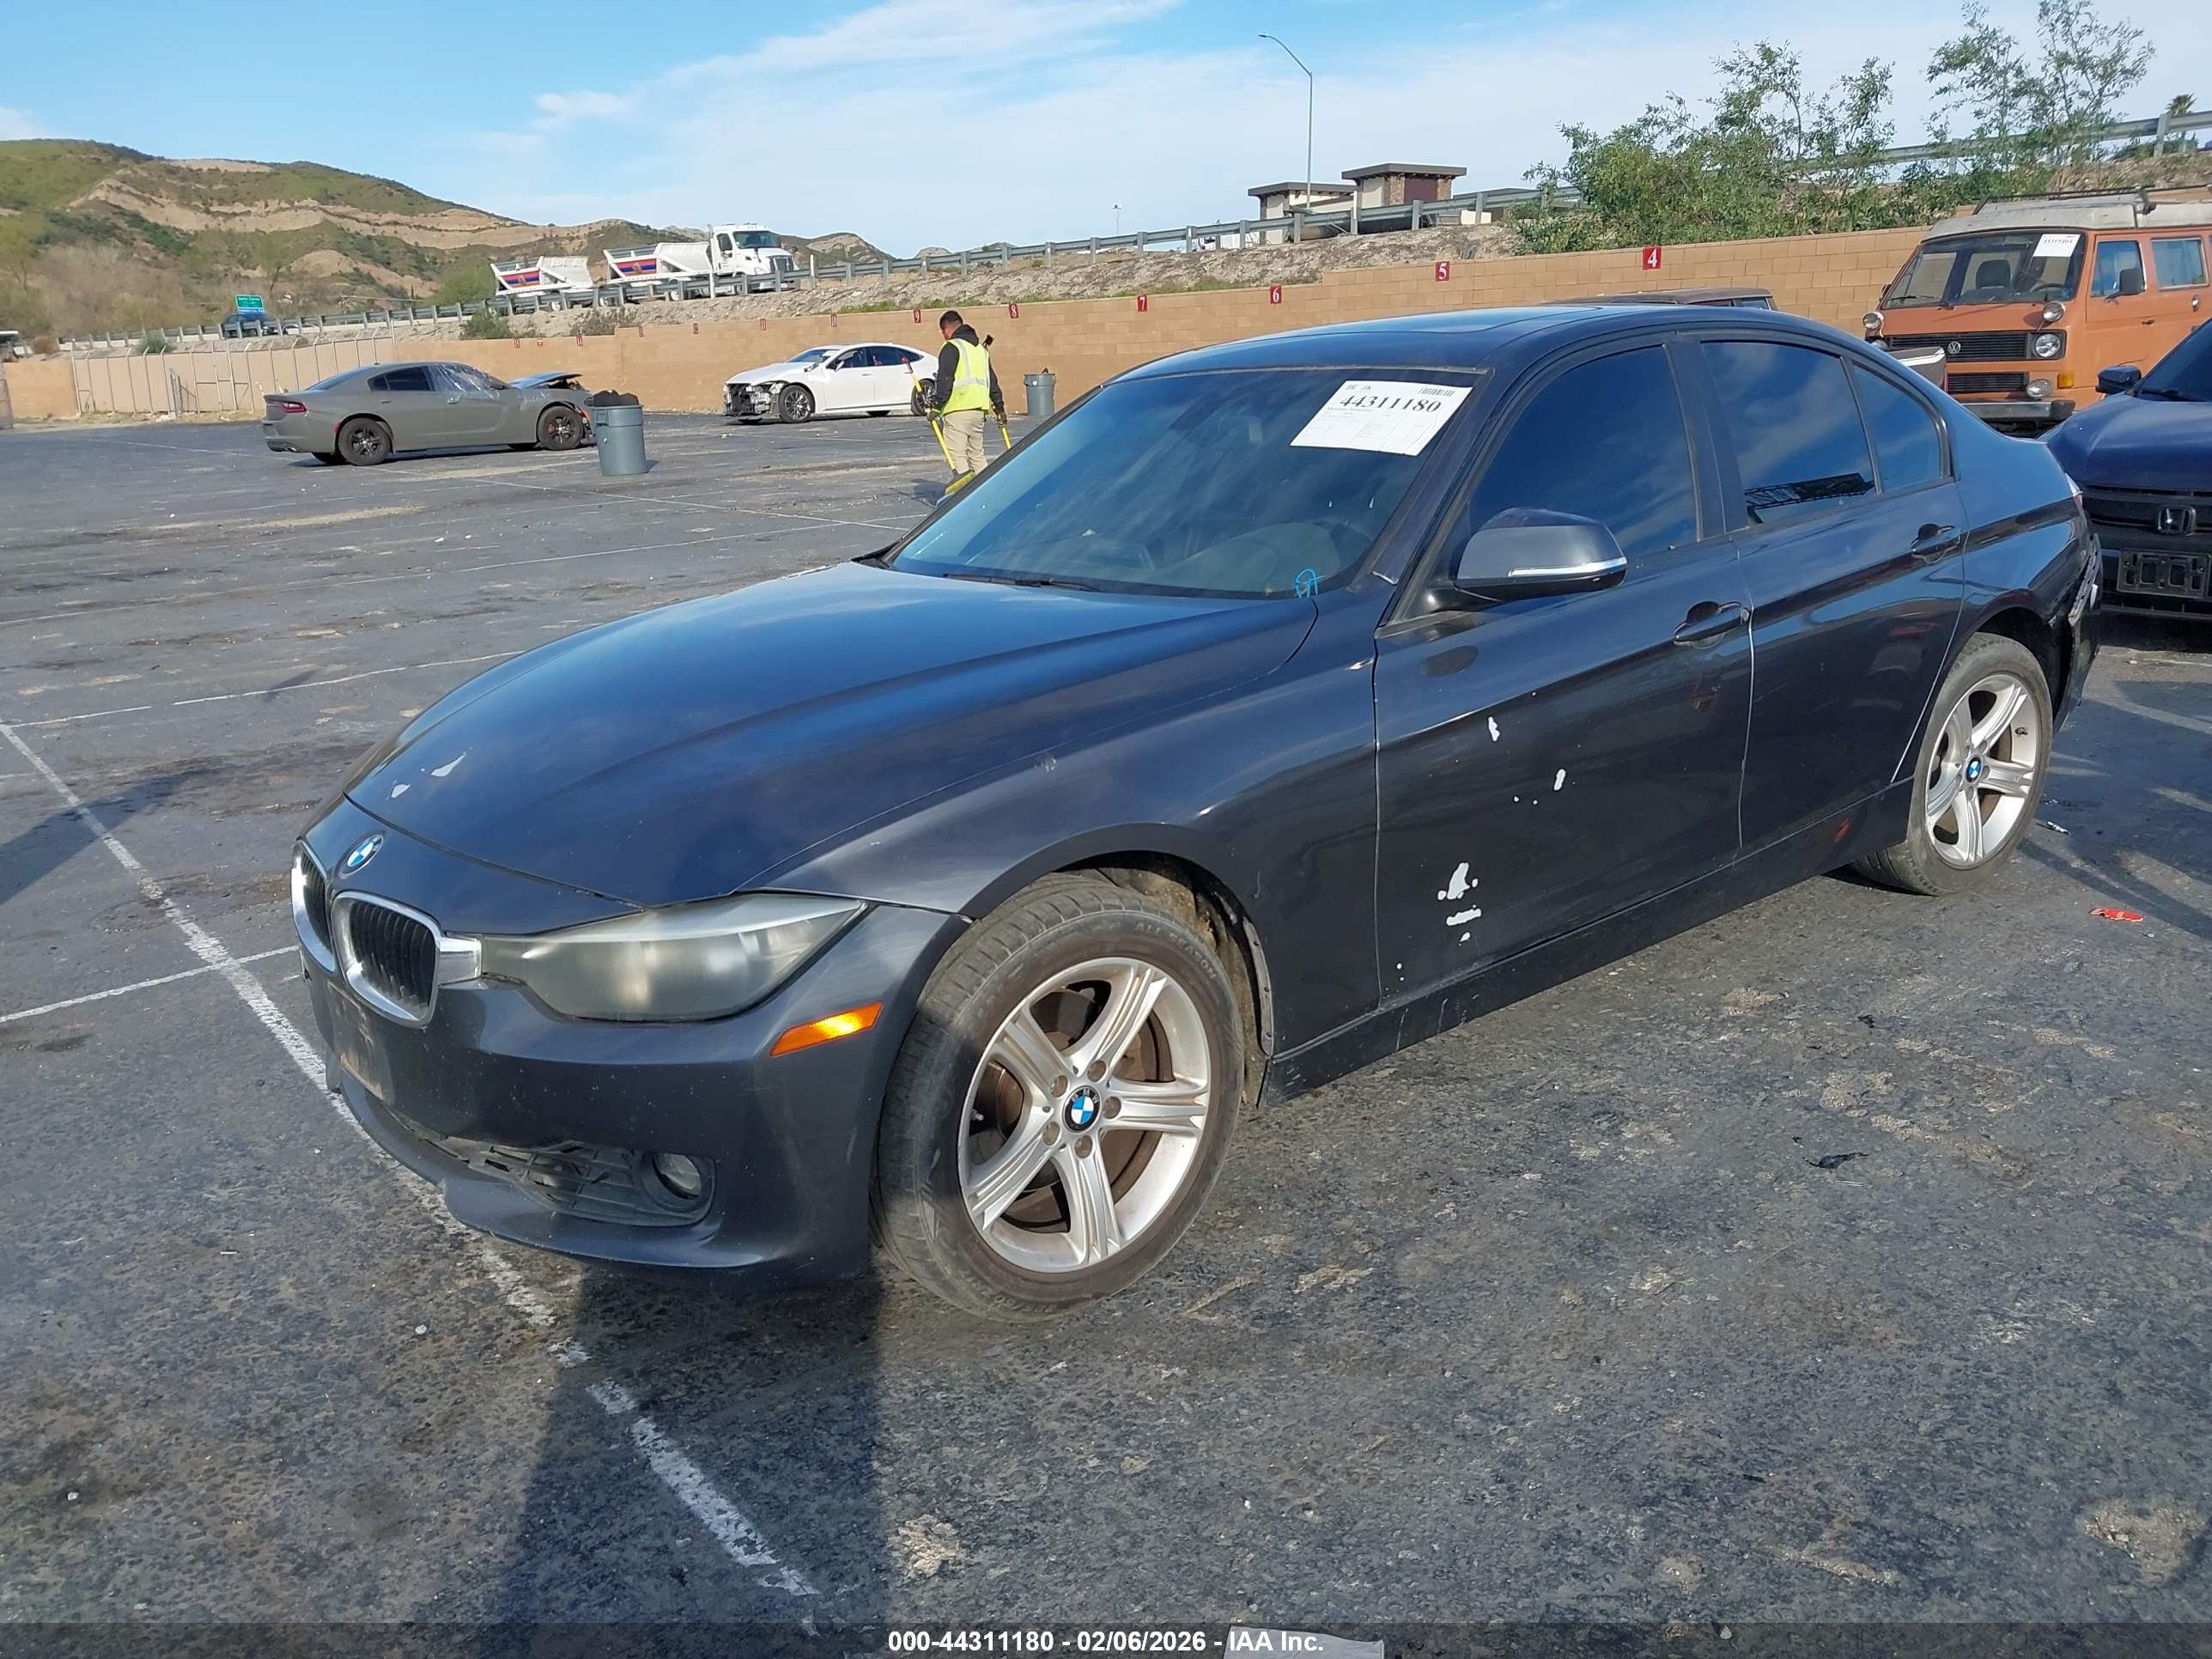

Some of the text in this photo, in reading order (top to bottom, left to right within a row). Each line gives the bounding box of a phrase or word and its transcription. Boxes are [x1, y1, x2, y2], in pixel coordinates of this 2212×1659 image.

[1647, 247, 1657, 268] 4
[1438, 264, 1447, 280] 5
[1273, 287, 1279, 302] 6
[1139, 296, 1145, 310] 7
[915, 311, 920, 322] 9
[1011, 305, 1017, 317] 8
[1340, 395, 1442, 412] 44311180
[1135, 922, 1161, 935] ALL
[1071, 1088, 1100, 1103] BMW
